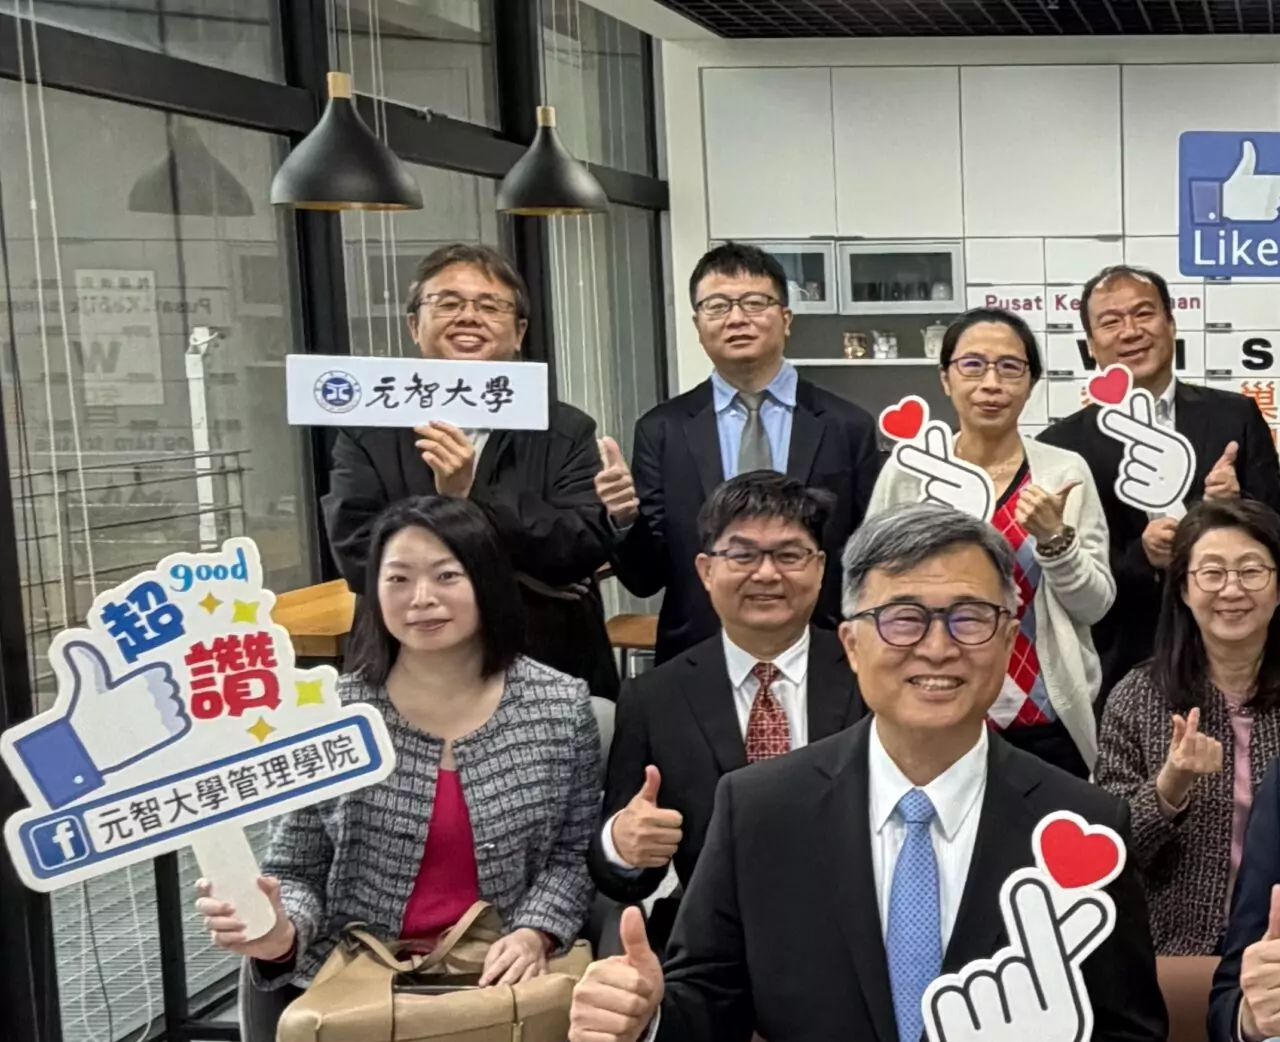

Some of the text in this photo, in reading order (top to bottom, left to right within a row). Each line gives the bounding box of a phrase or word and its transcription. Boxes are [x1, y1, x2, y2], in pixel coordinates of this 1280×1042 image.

[1194, 230, 1279, 266] Like
[365, 372, 515, 414] 元智大學
[169, 547, 249, 593] good
[98, 734, 360, 846] 元智大學管理學院
